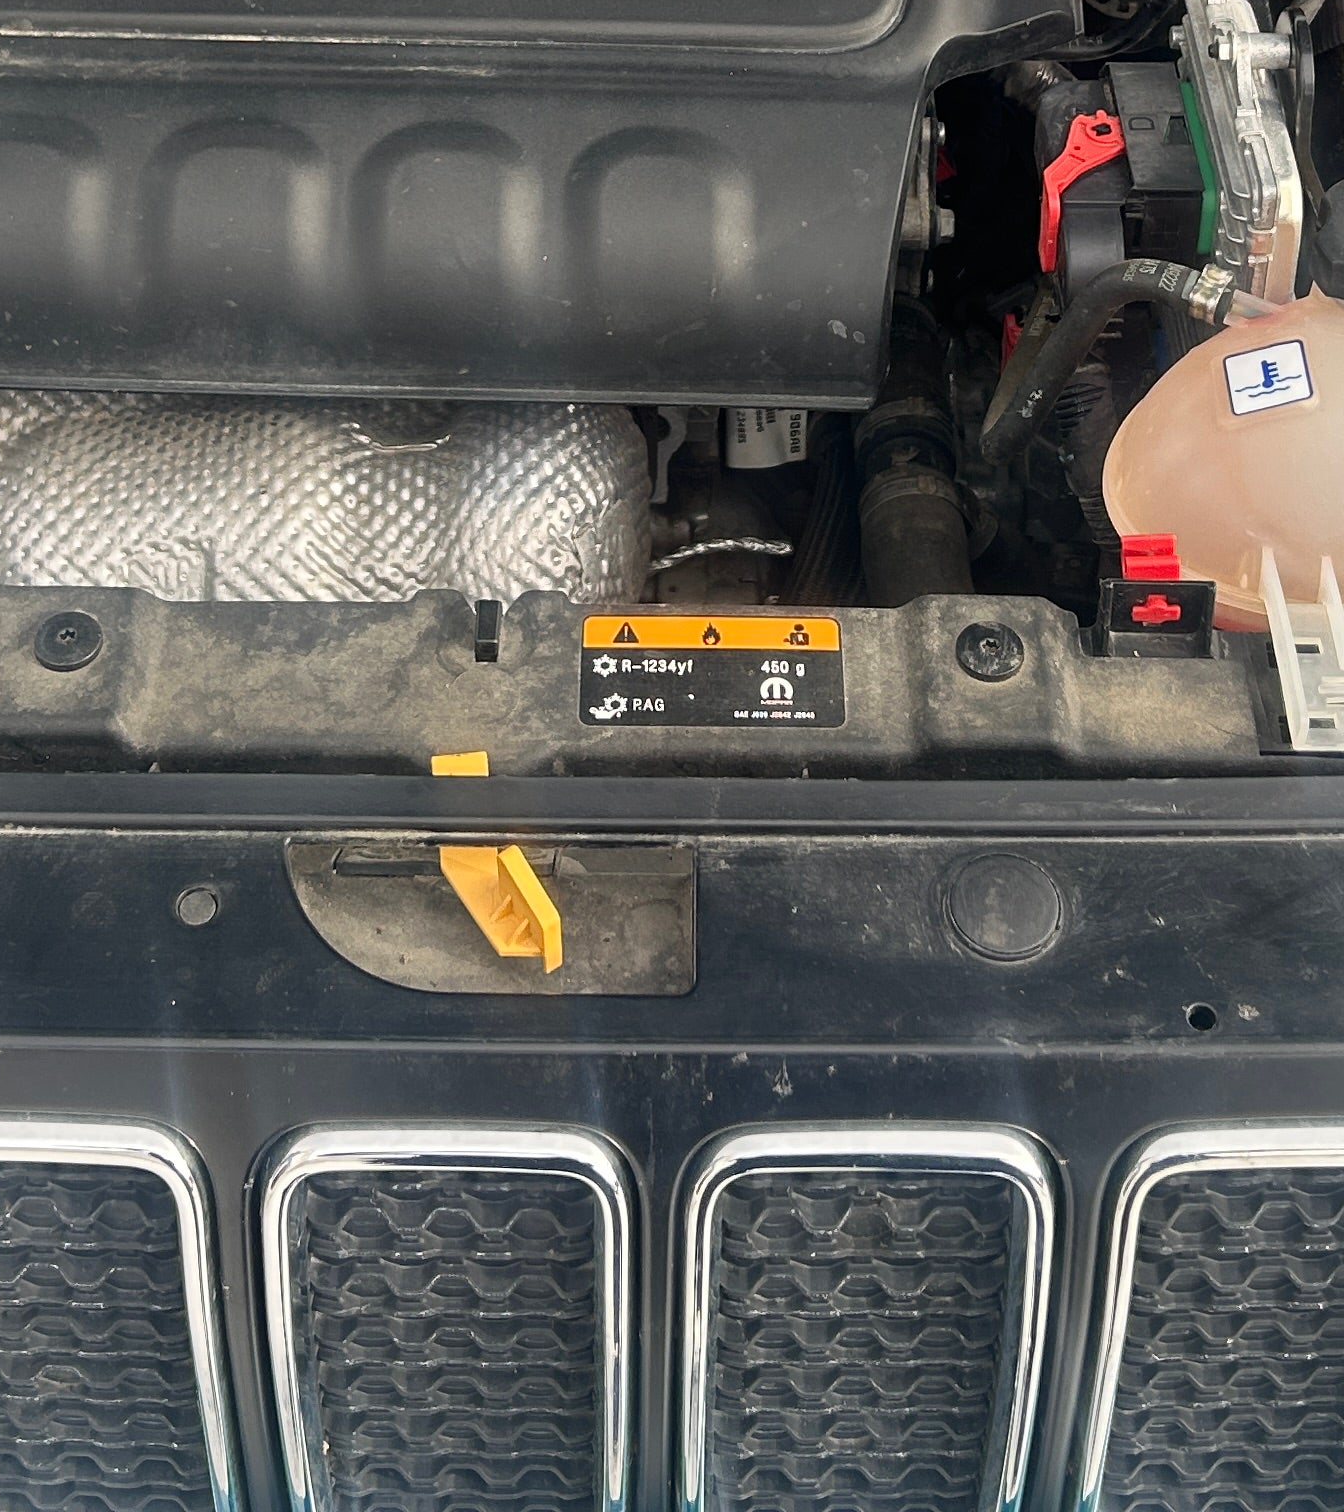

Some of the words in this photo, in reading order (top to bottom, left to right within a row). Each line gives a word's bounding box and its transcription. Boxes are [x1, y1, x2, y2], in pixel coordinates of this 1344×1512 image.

[621, 659, 693, 676] R-1234yf
[761, 660, 789, 674] 450
[795, 663, 805, 676] g
[632, 697, 665, 712] PAG
